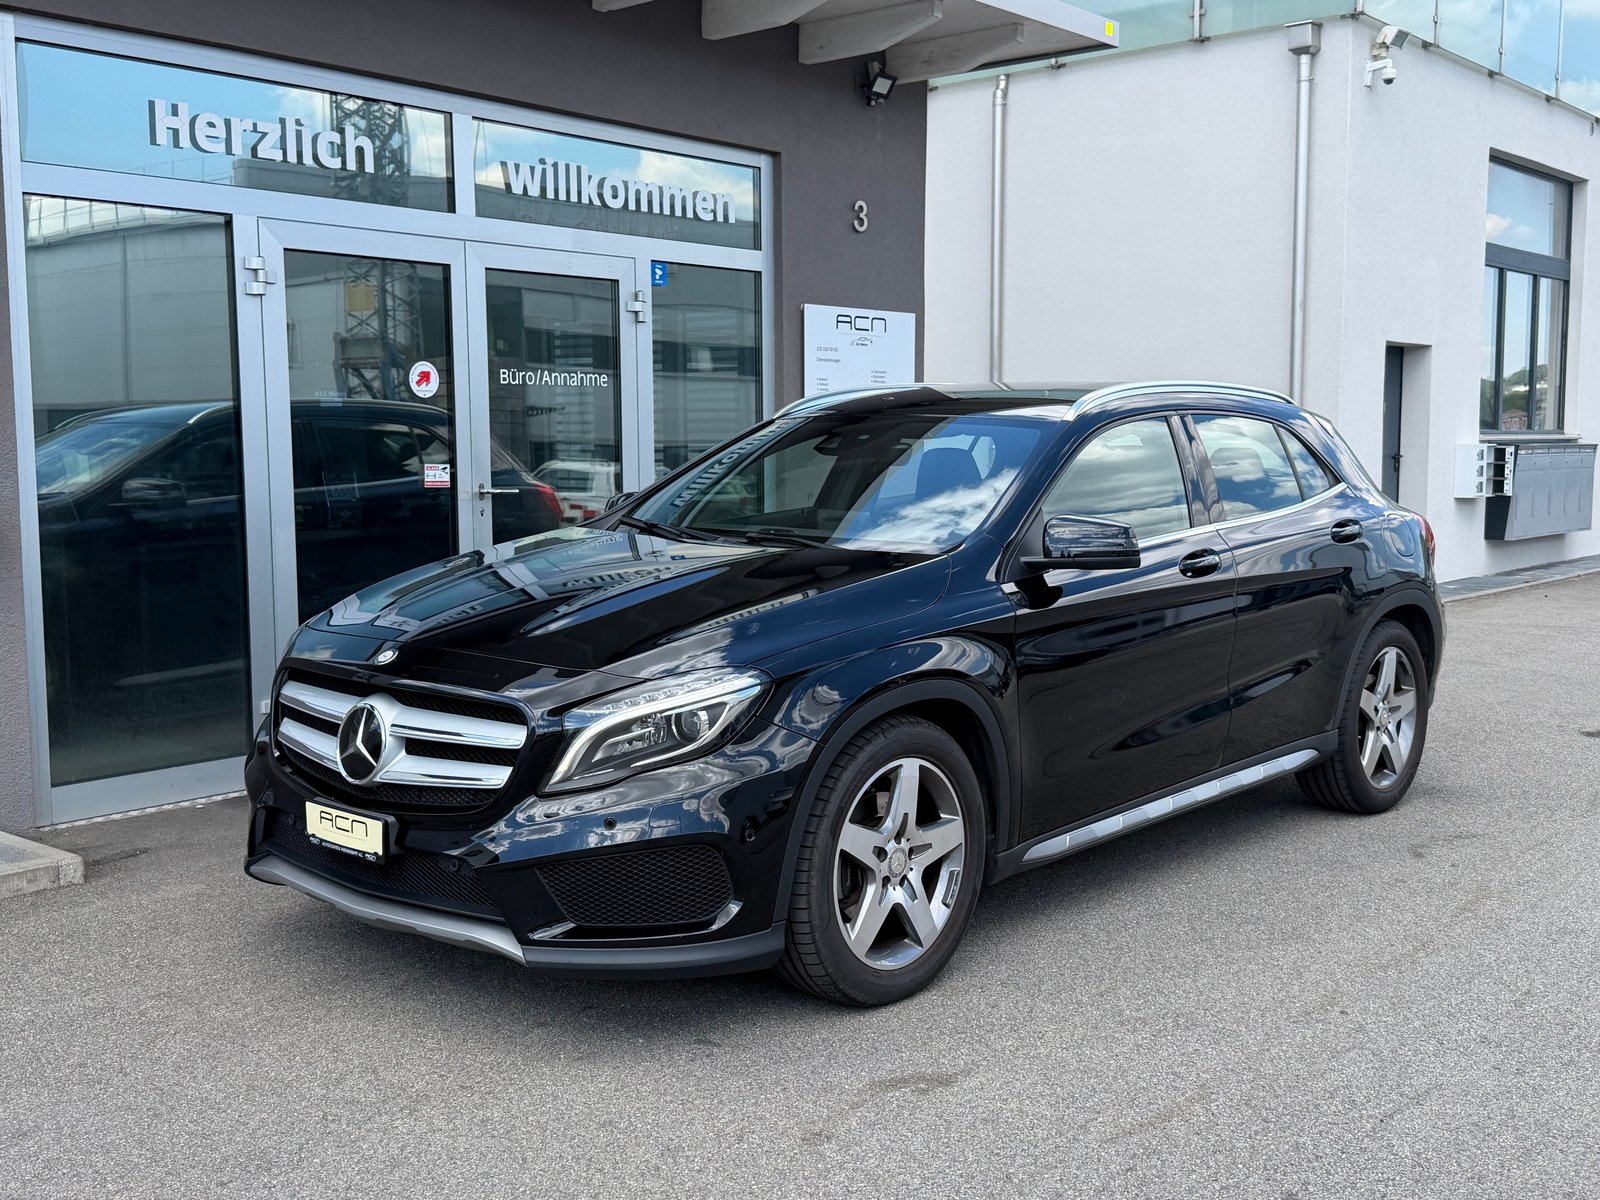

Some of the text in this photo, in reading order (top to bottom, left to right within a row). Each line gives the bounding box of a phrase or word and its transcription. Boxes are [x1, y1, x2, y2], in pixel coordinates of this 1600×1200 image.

[149, 99, 375, 174] Herzlich
[501, 157, 736, 224] willkommen
[854, 200, 868, 232] 3
[499, 368, 608, 387] Büro/Annahme
